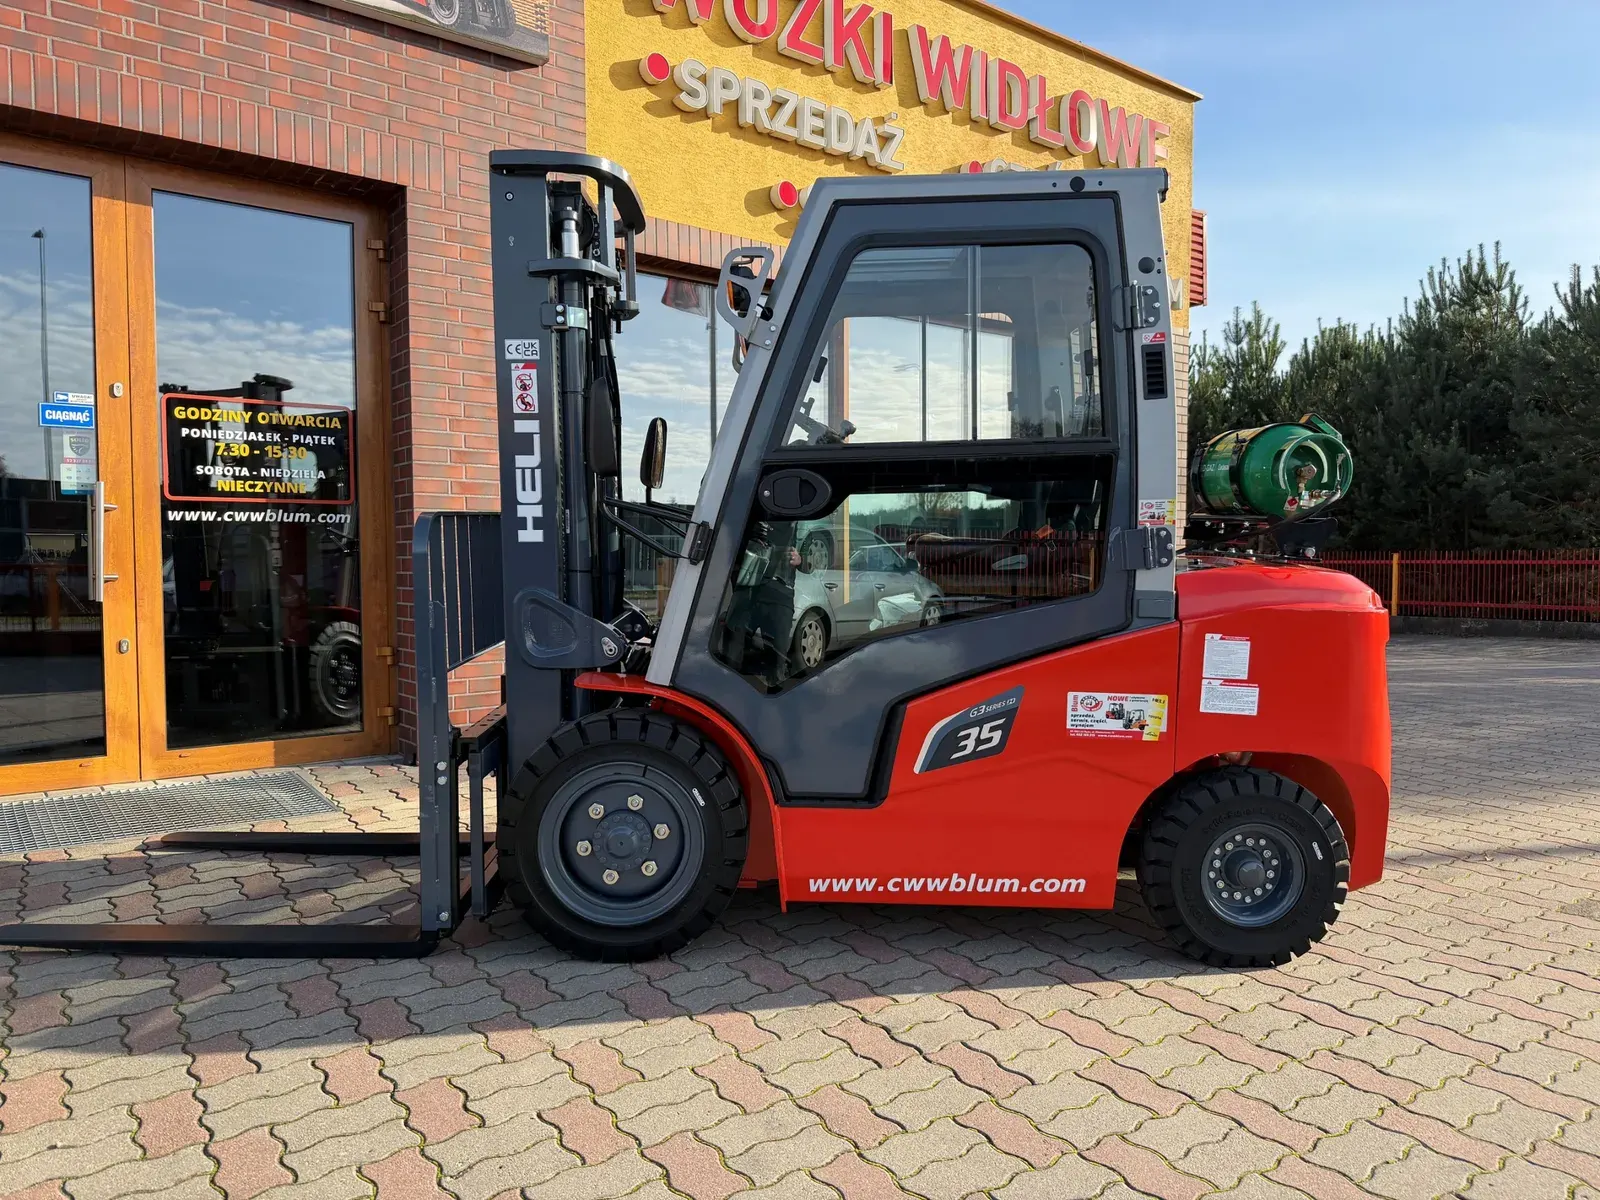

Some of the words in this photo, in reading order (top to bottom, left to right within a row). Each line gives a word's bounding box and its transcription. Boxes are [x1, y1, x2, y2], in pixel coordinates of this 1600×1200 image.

[672, 58, 905, 173] SPRZEDAŻ
[45, 409, 90, 423] CIĄGNĄĆ
[174, 406, 252, 423] GODZINY
[257, 412, 342, 429] OTWARCIA
[181, 427, 281, 443] PONIEDZIAŁEK
[292, 434, 336, 447] PIĄTEK
[215, 442, 250, 456] 7.30
[196, 465, 250, 477] SOBOTA
[260, 468, 326, 480] NIEDZIELA
[513, 419, 544, 543] HELI
[217, 480, 307, 494] NIECZYNNE
[167, 509, 351, 524] www.cwwblum.com
[969, 705, 986, 718] G3
[985, 700, 1006, 713] SERIES
[949, 717, 1007, 760] 35
[807, 873, 1087, 893] www.cwwblum.com
